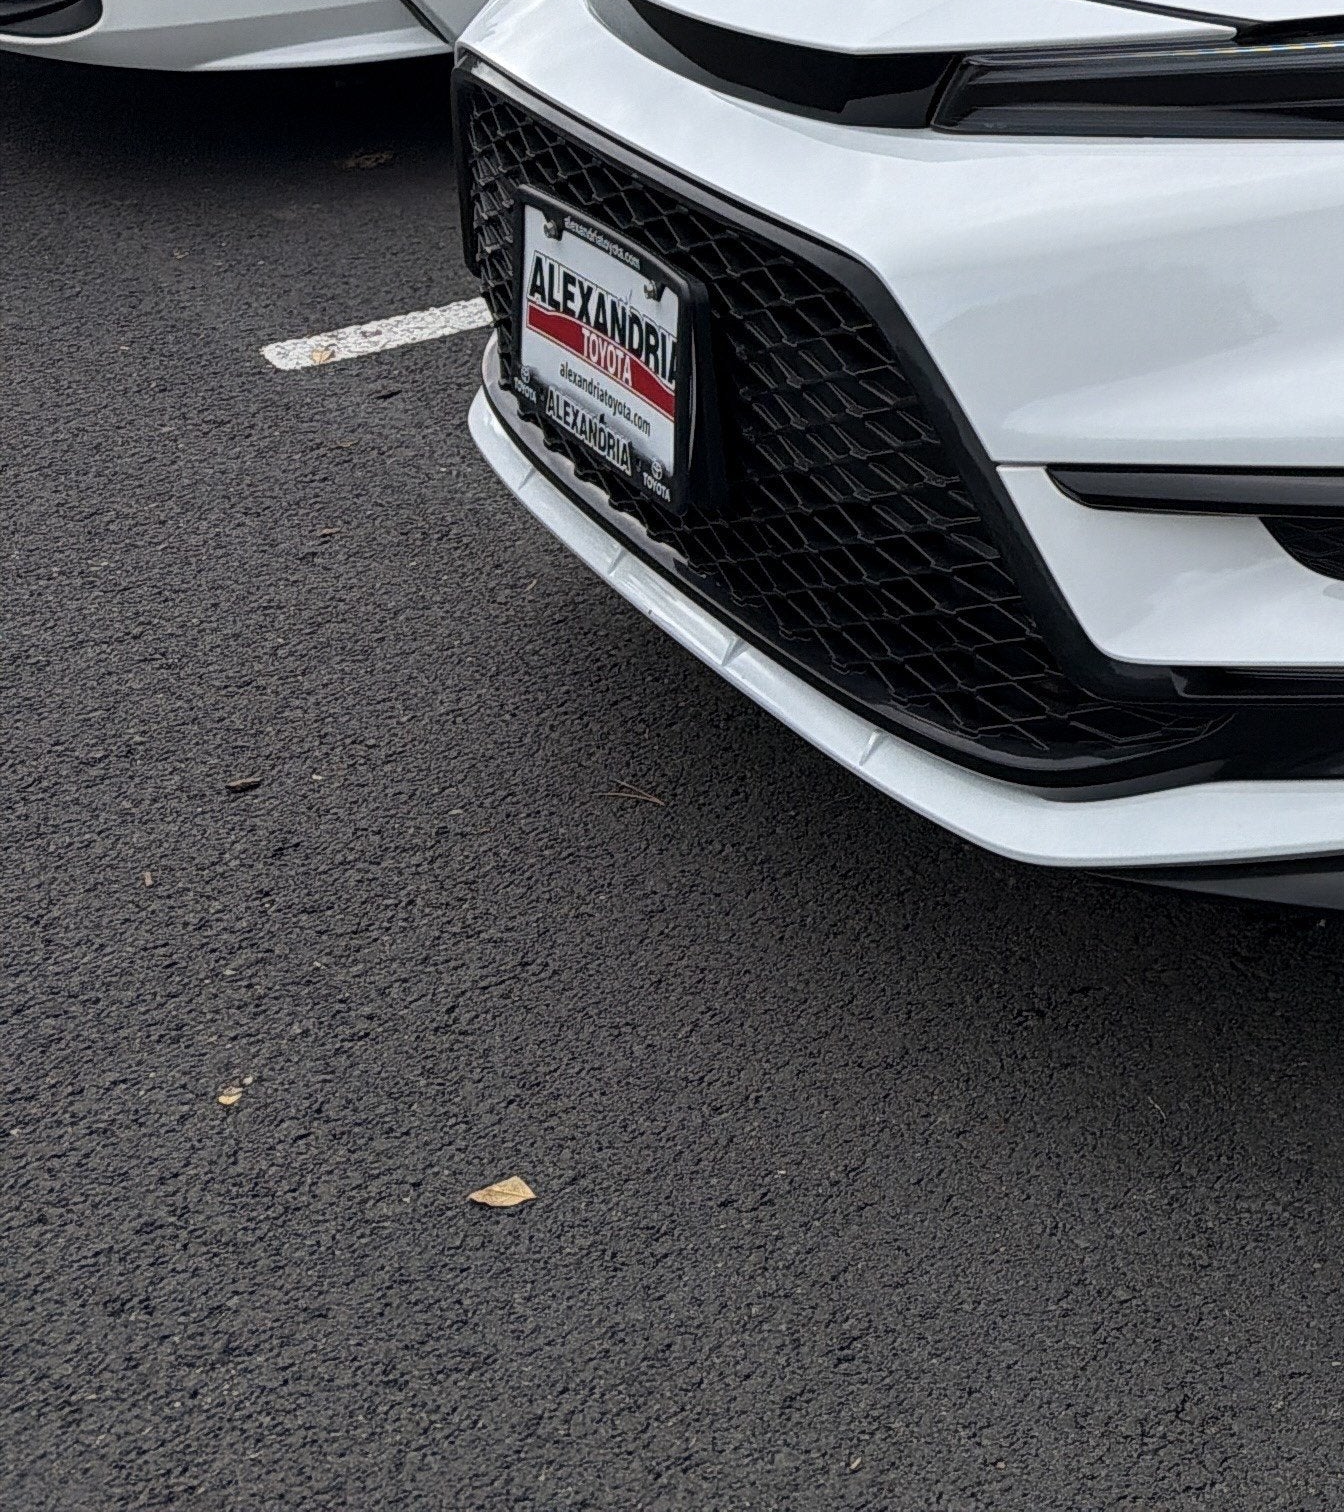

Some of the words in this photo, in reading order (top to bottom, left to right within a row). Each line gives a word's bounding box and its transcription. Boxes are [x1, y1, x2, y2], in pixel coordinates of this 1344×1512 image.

[582, 327, 633, 387] TOYOTA
[546, 386, 632, 476] ALEXANDRIA
[559, 361, 651, 437] alexandriatoyota.com
[642, 472, 671, 503] TOYOTA
